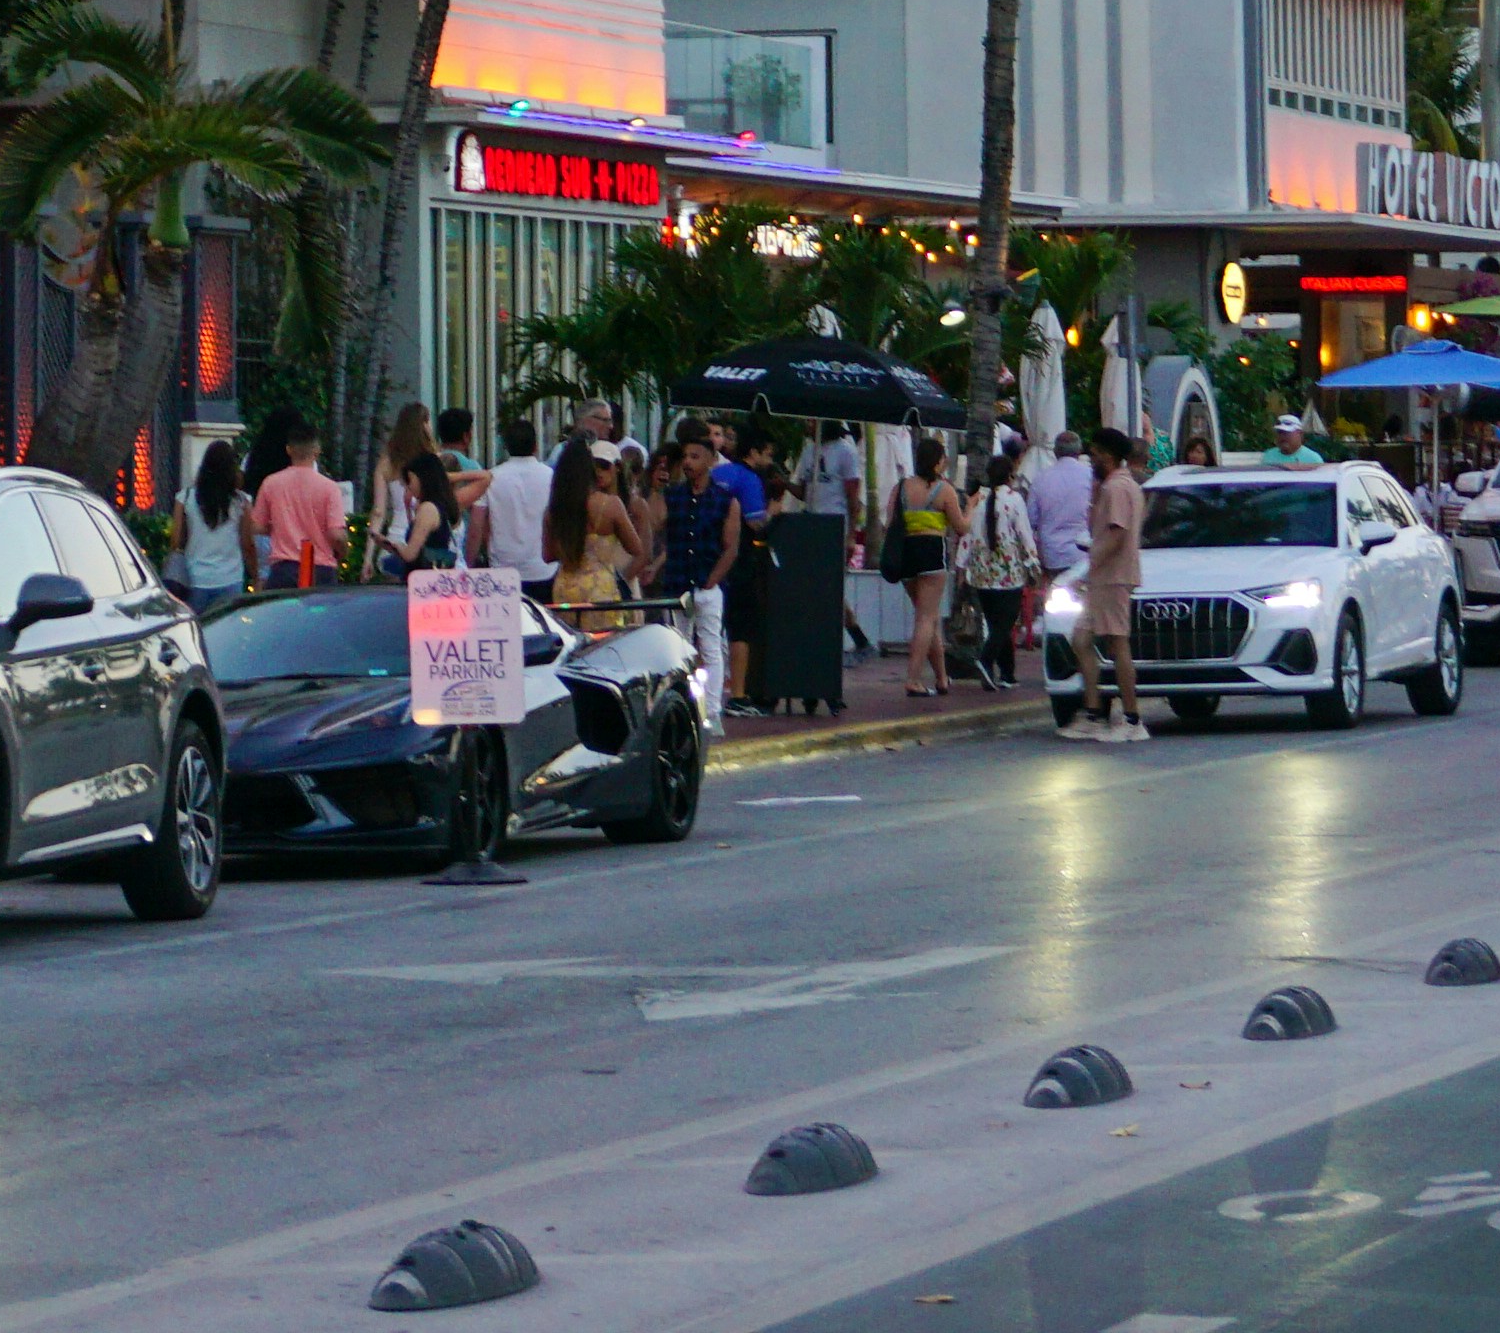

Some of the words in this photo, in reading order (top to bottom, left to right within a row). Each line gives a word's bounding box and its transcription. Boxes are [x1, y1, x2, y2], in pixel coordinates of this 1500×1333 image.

[485, 146, 557, 197] REDHEAD
[615, 160, 660, 206] PIZZA
[1367, 142, 1437, 223] HOTEL
[1300, 276, 1354, 291] ITALIAN
[1354, 275, 1407, 291] CUISINE
[704, 365, 769, 381] VALET
[424, 639, 509, 663] VALET
[429, 663, 506, 680] PARKING
